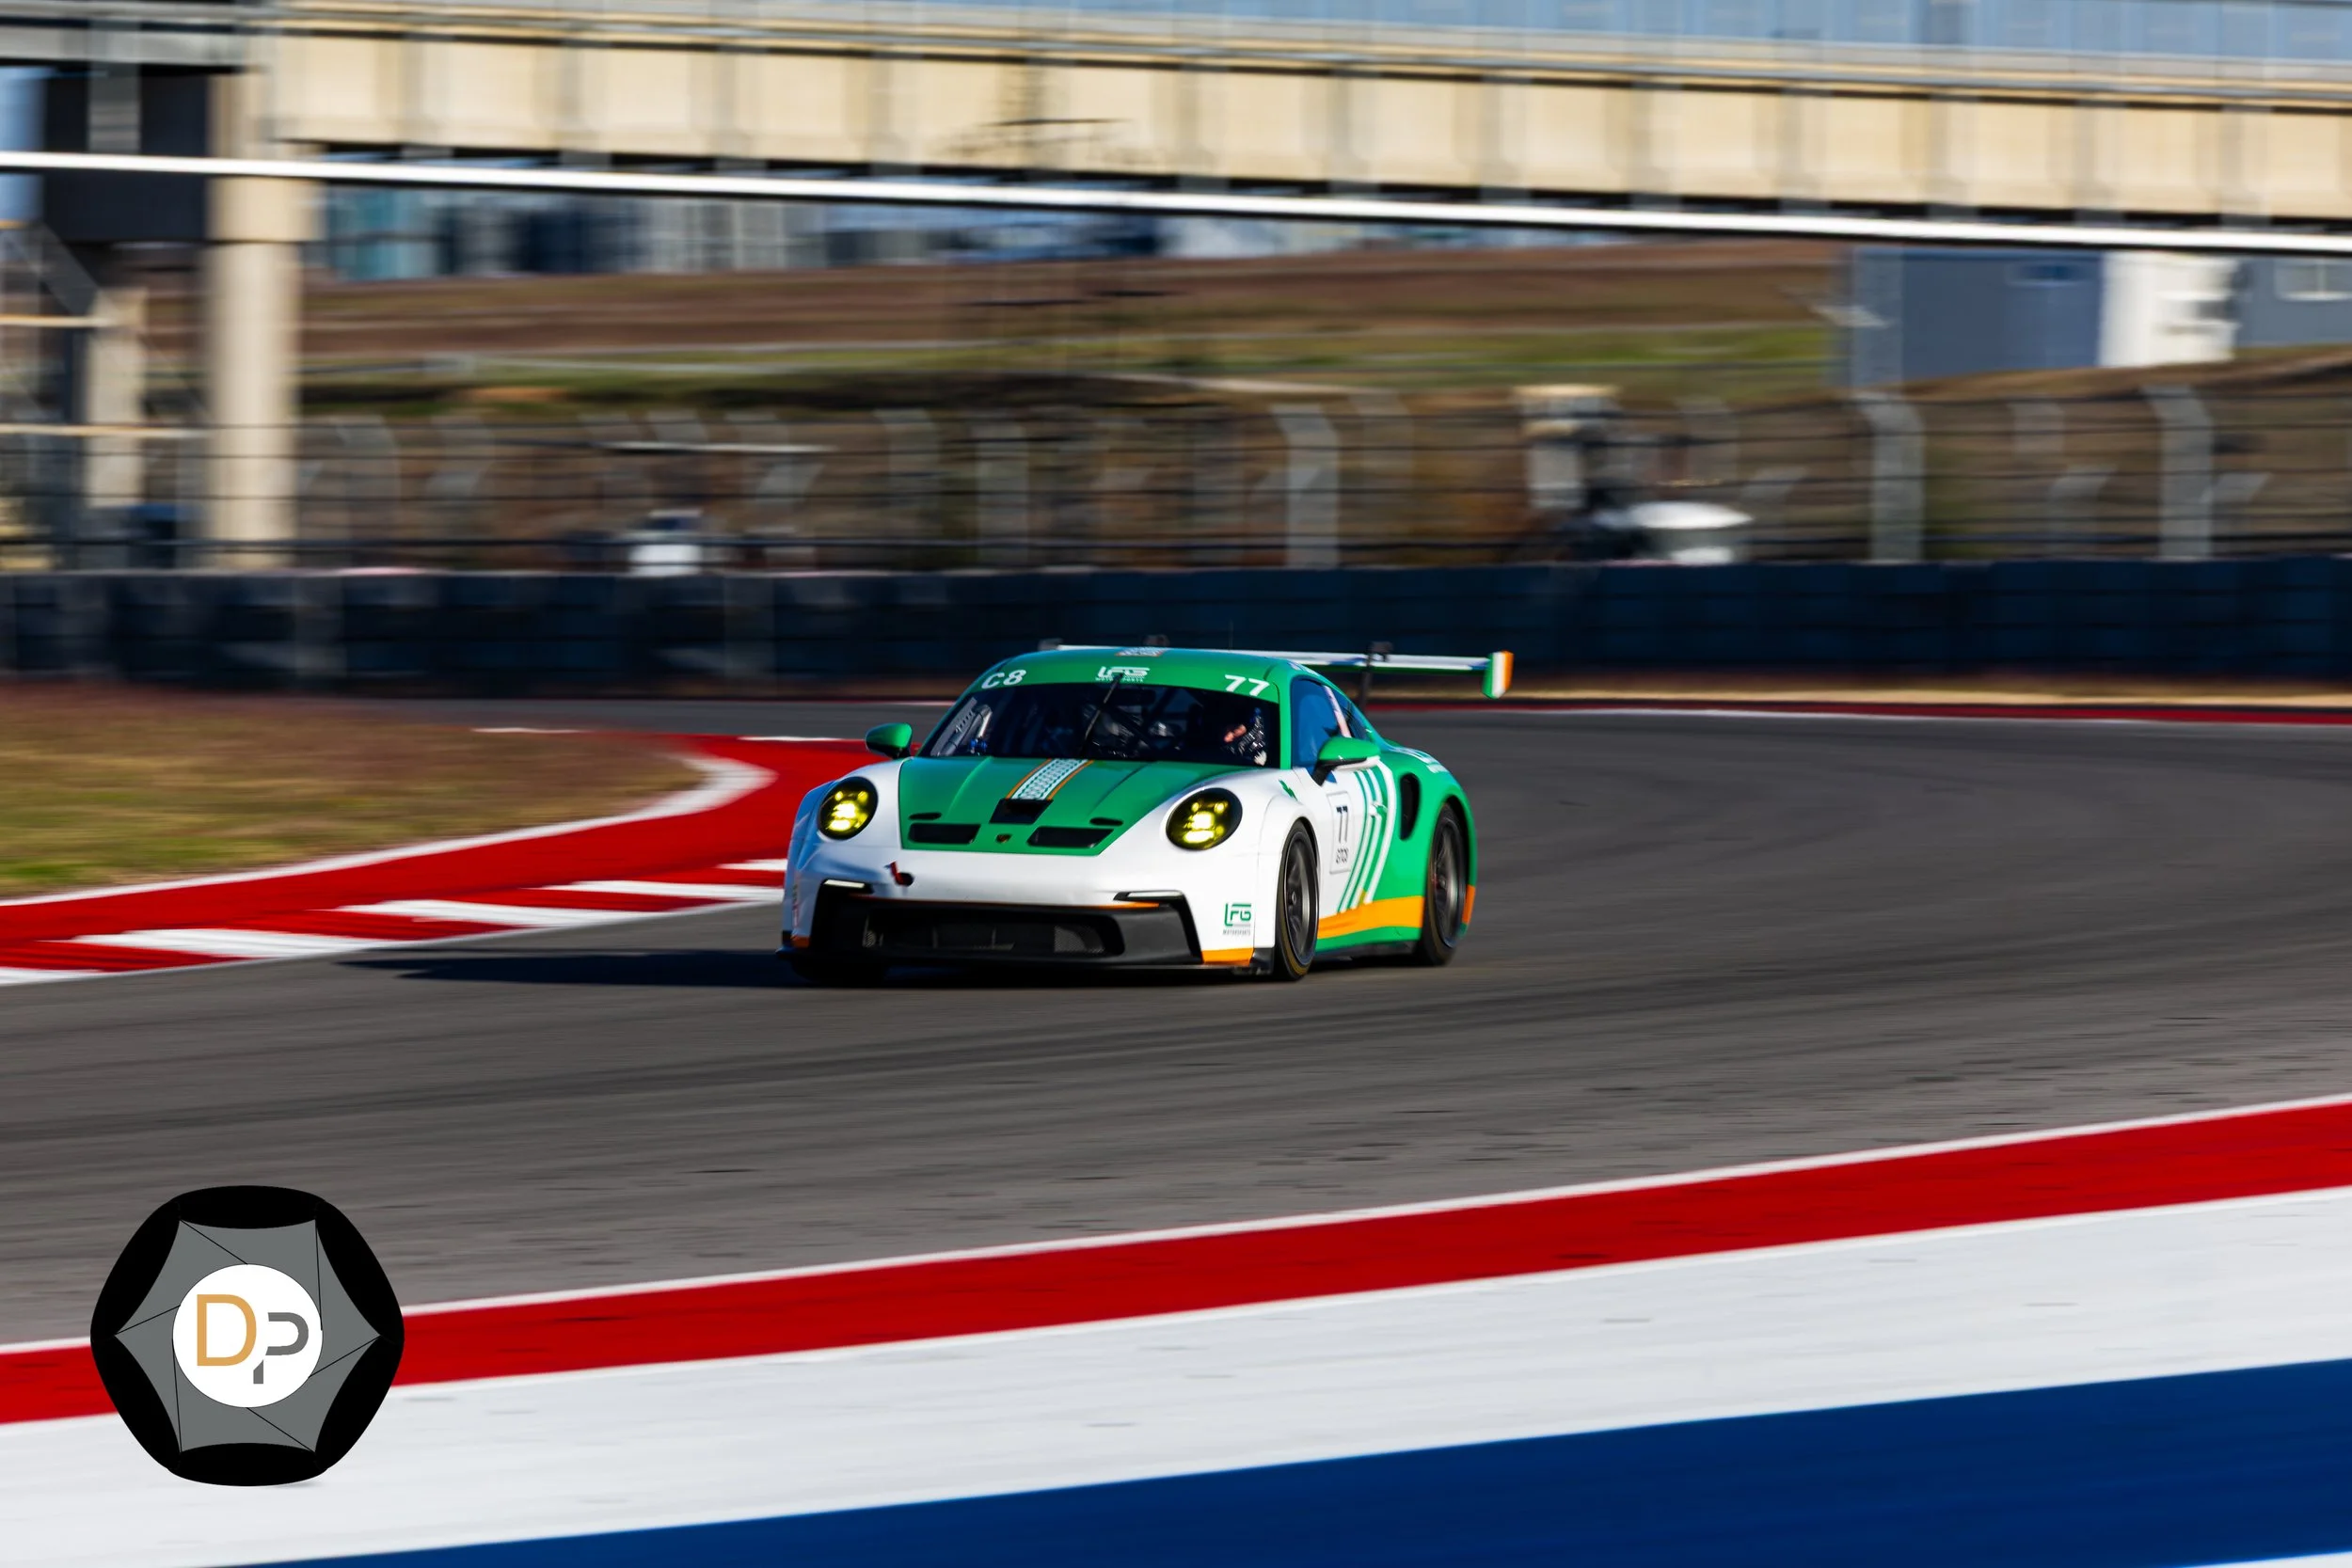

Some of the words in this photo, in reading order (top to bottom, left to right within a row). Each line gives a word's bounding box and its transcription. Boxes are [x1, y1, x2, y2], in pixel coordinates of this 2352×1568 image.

[981, 669, 1026, 689] C8
[1224, 673, 1270, 697] 77
[1336, 805, 1348, 844] 77
[1224, 903, 1252, 927] LFG
